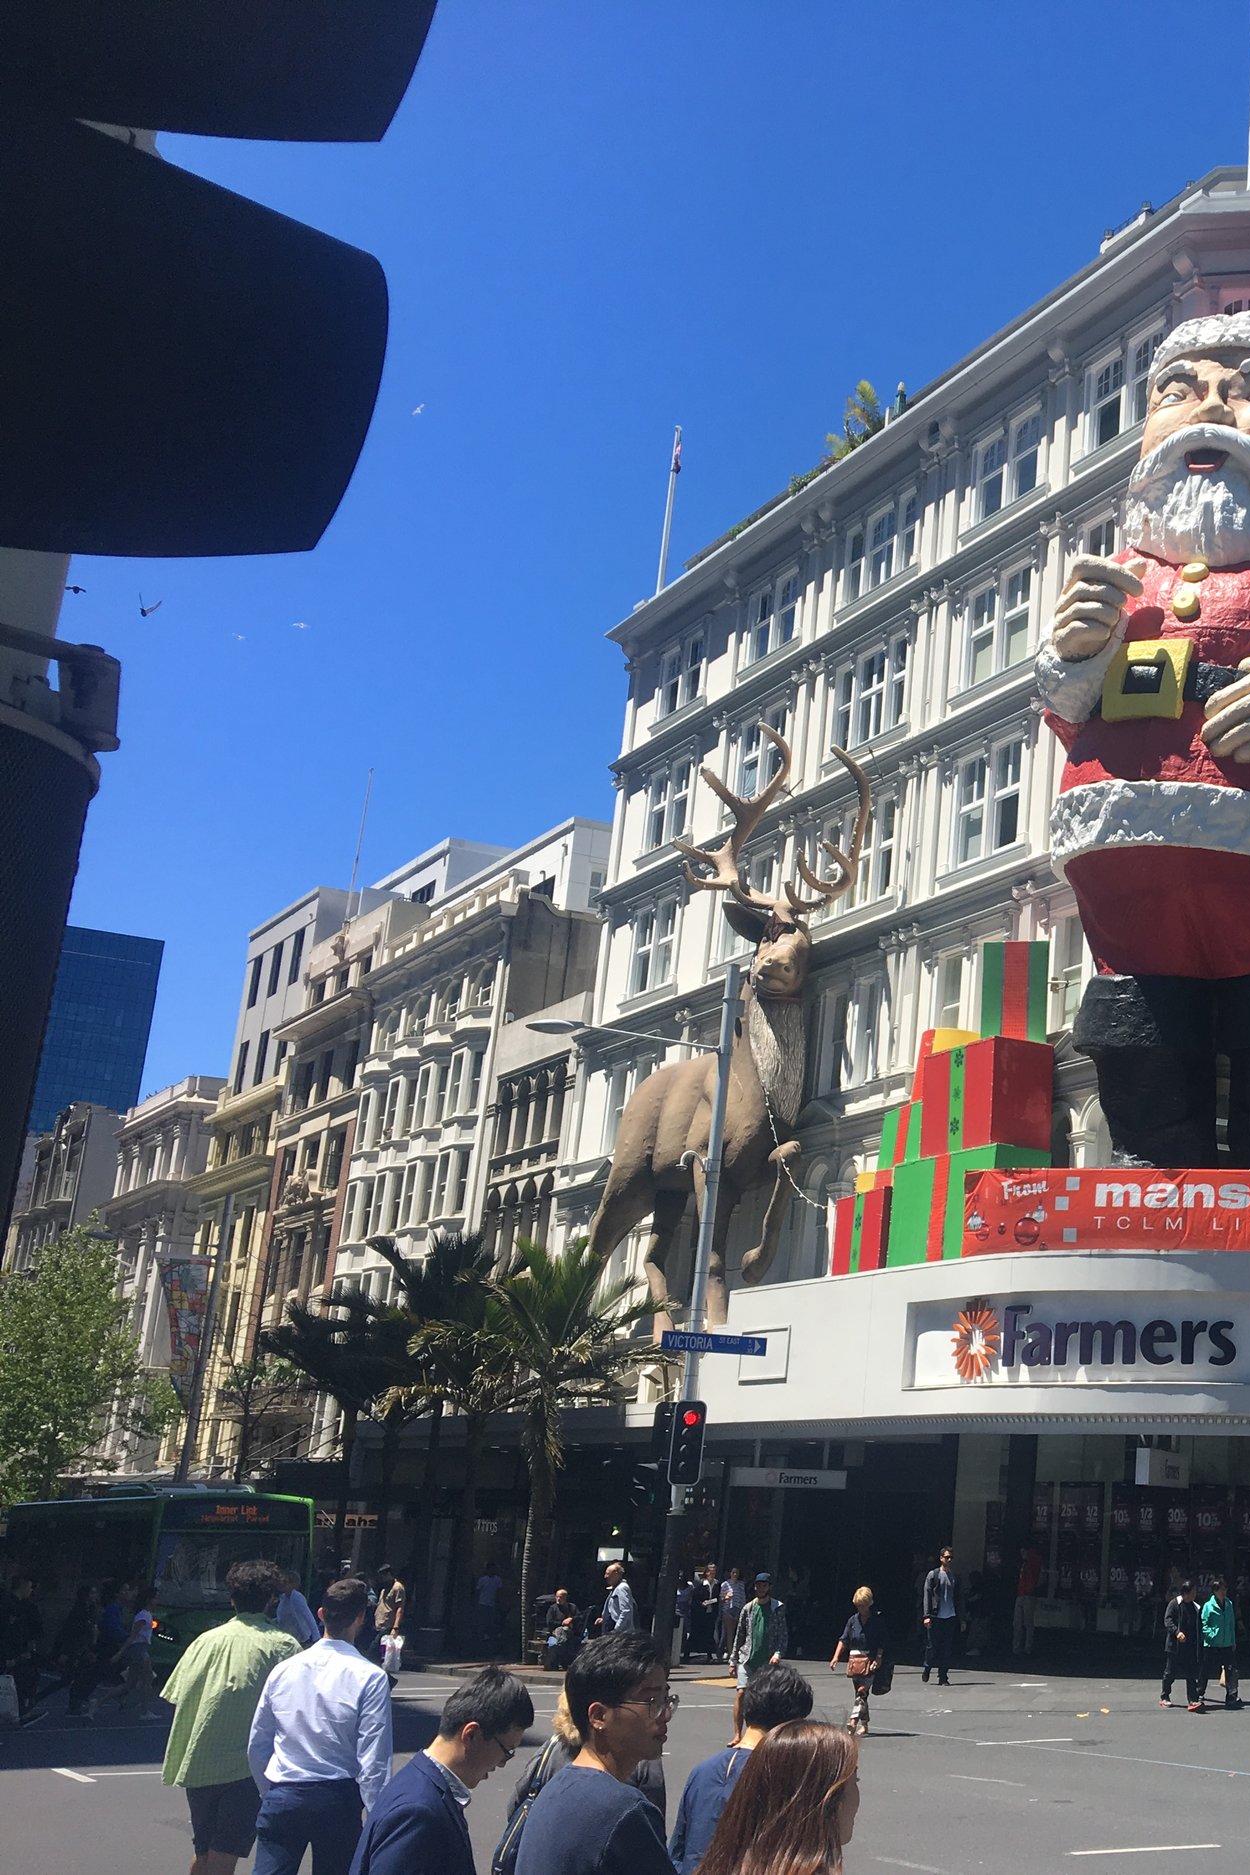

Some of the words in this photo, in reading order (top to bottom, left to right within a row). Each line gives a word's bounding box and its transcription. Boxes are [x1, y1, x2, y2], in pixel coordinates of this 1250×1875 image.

[1001, 1180, 1050, 1200] From
[1094, 1215, 1184, 1232] TCLM
[667, 1334, 713, 1350] VICTORIA
[726, 1337, 740, 1345] EAST
[1000, 1305, 1238, 1367] Farmers
[778, 1471, 818, 1485] Farmers
[1086, 1506, 1098, 1517] 1/2
[1139, 1507, 1153, 1520] 1/2
